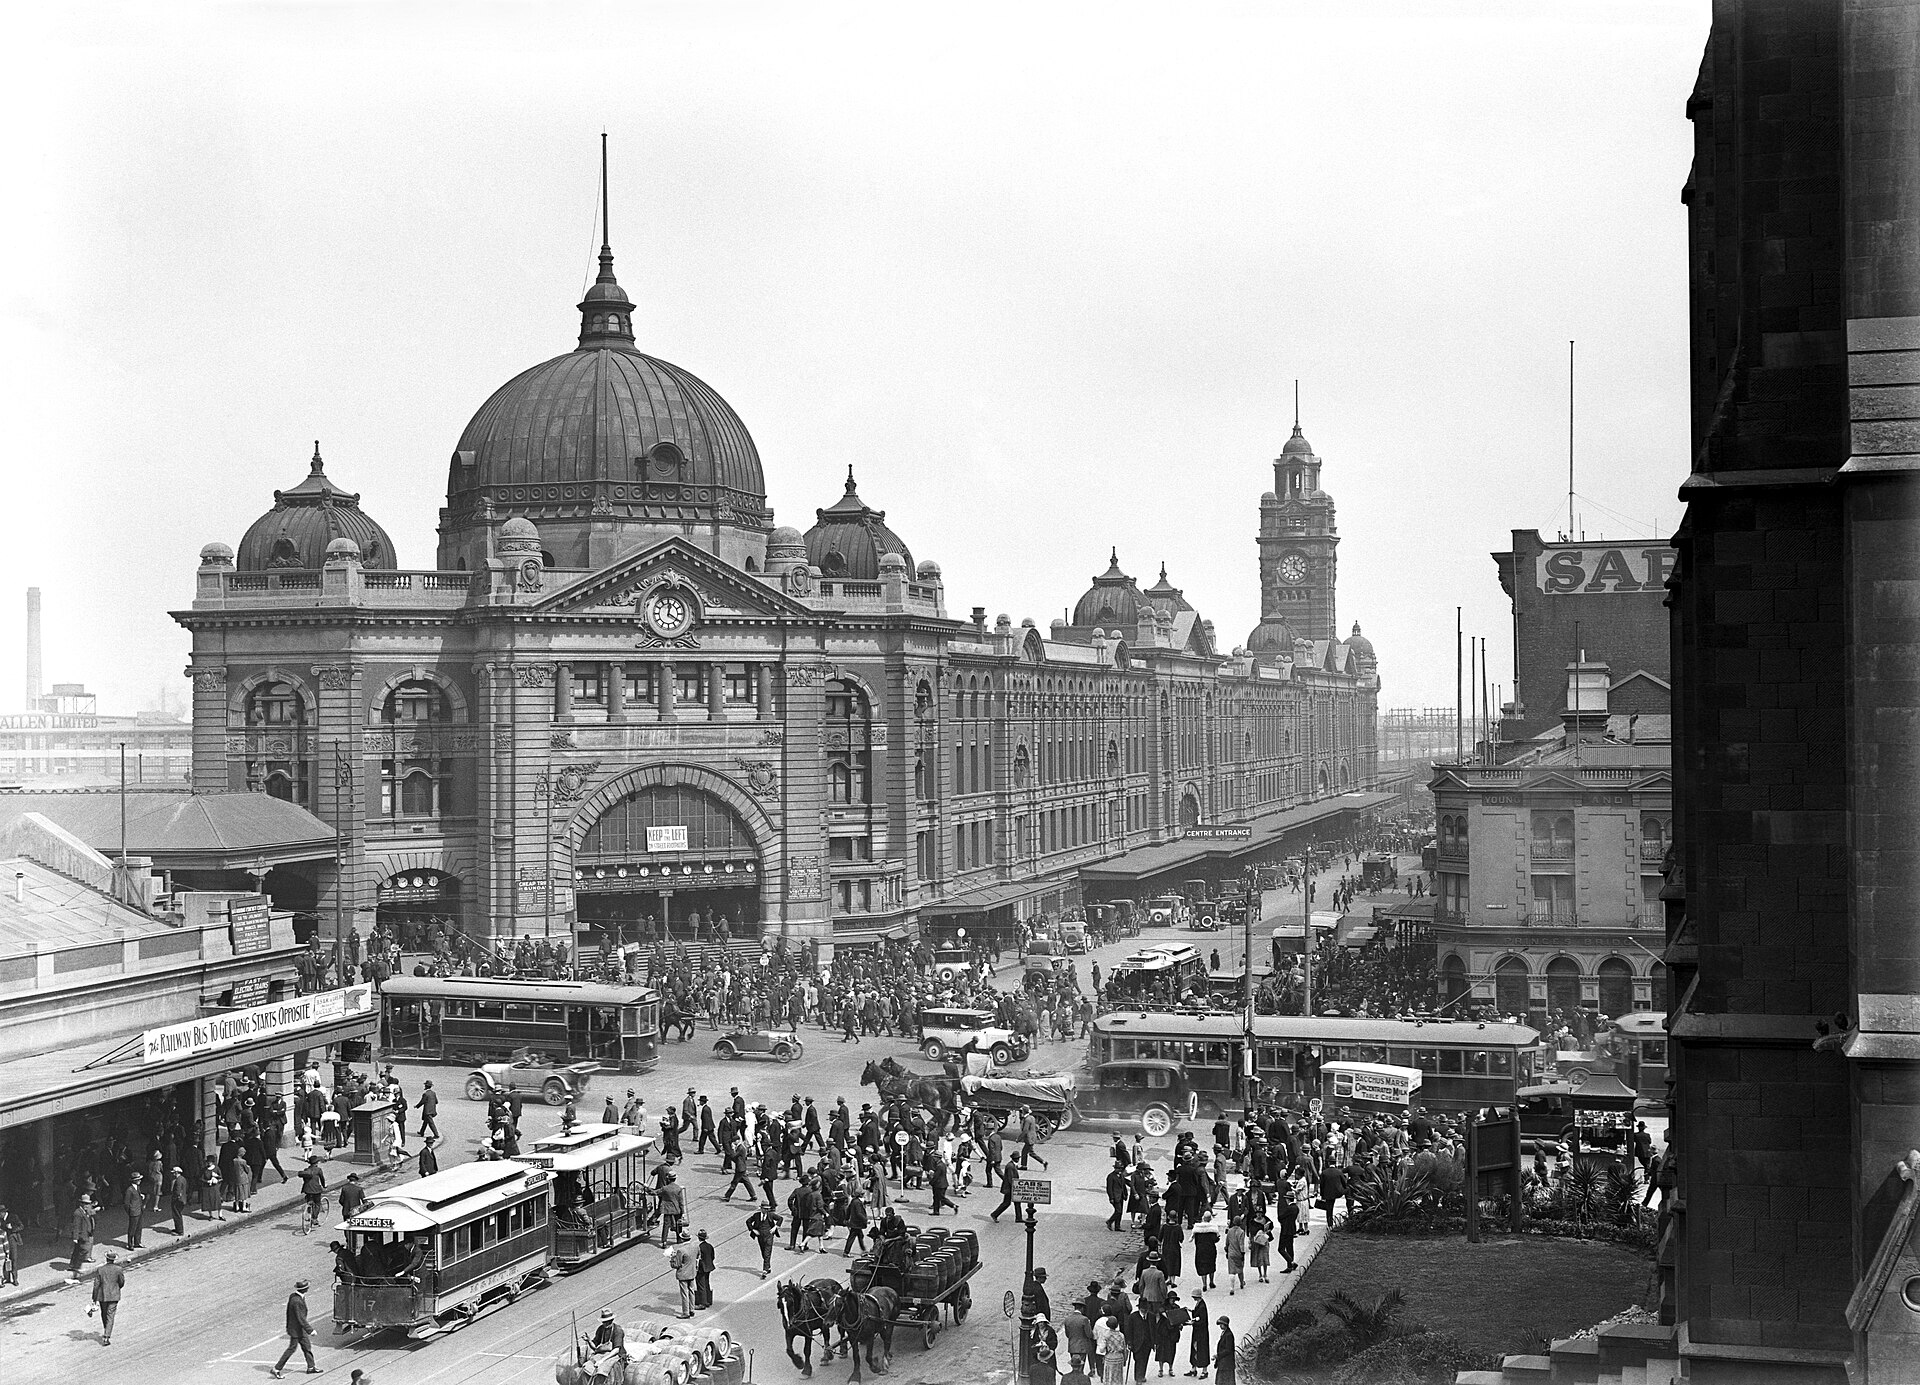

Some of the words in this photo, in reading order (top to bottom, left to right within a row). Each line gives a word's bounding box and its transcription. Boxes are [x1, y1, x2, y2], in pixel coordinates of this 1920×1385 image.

[0, 715, 46, 729] ALLEN
[52, 717, 98, 729] LIMITED
[649, 829, 663, 841] KEEP
[672, 829, 686, 840] LEFT
[245, 978, 262, 986] FAST
[161, 1030, 192, 1054] RAILWAY
[193, 1021, 208, 1046] BUS
[209, 1017, 218, 1042] TO
[219, 1014, 249, 1039] GEELONG
[252, 1010, 276, 1032] STARTS
[279, 1003, 310, 1025] OPPOSITE
[1355, 1073, 1384, 1084] BACCHUS
[1385, 1077, 1408, 1087] MARSH
[1355, 1083, 1392, 1094] CONCENTRATED
[1393, 1087, 1408, 1096] MILK
[351, 1218, 382, 1227] SPENCER
